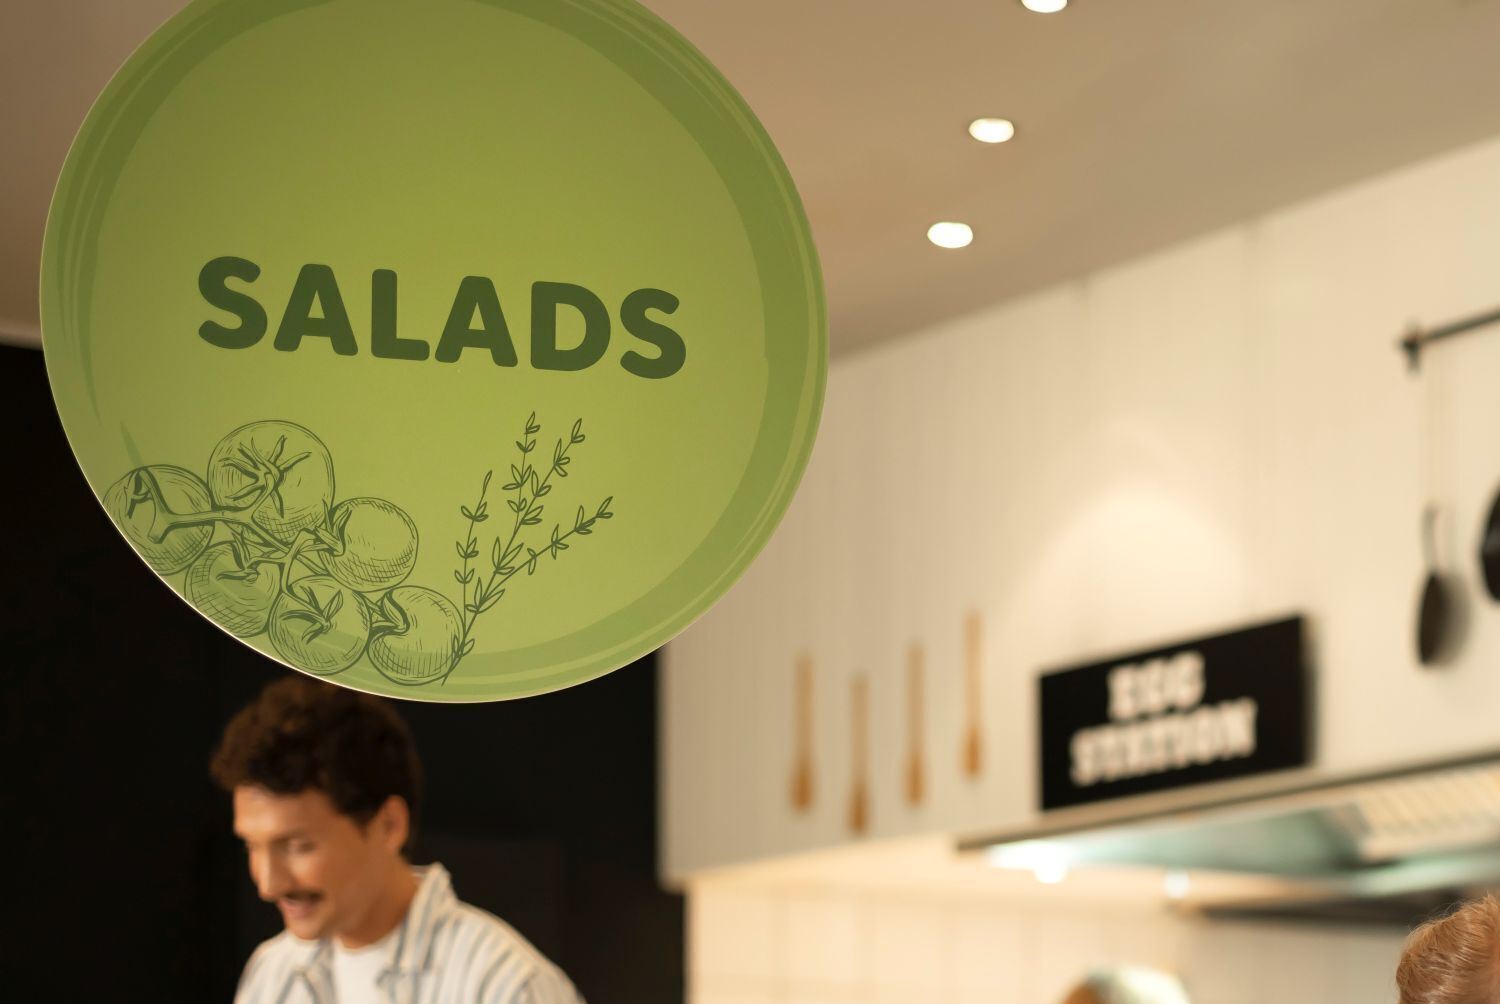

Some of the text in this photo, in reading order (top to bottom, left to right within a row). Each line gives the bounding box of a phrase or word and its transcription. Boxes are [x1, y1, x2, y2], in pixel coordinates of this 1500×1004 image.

[197, 255, 688, 380] SALADS
[1107, 650, 1206, 720] EGG
[1070, 696, 1258, 787] STATION
